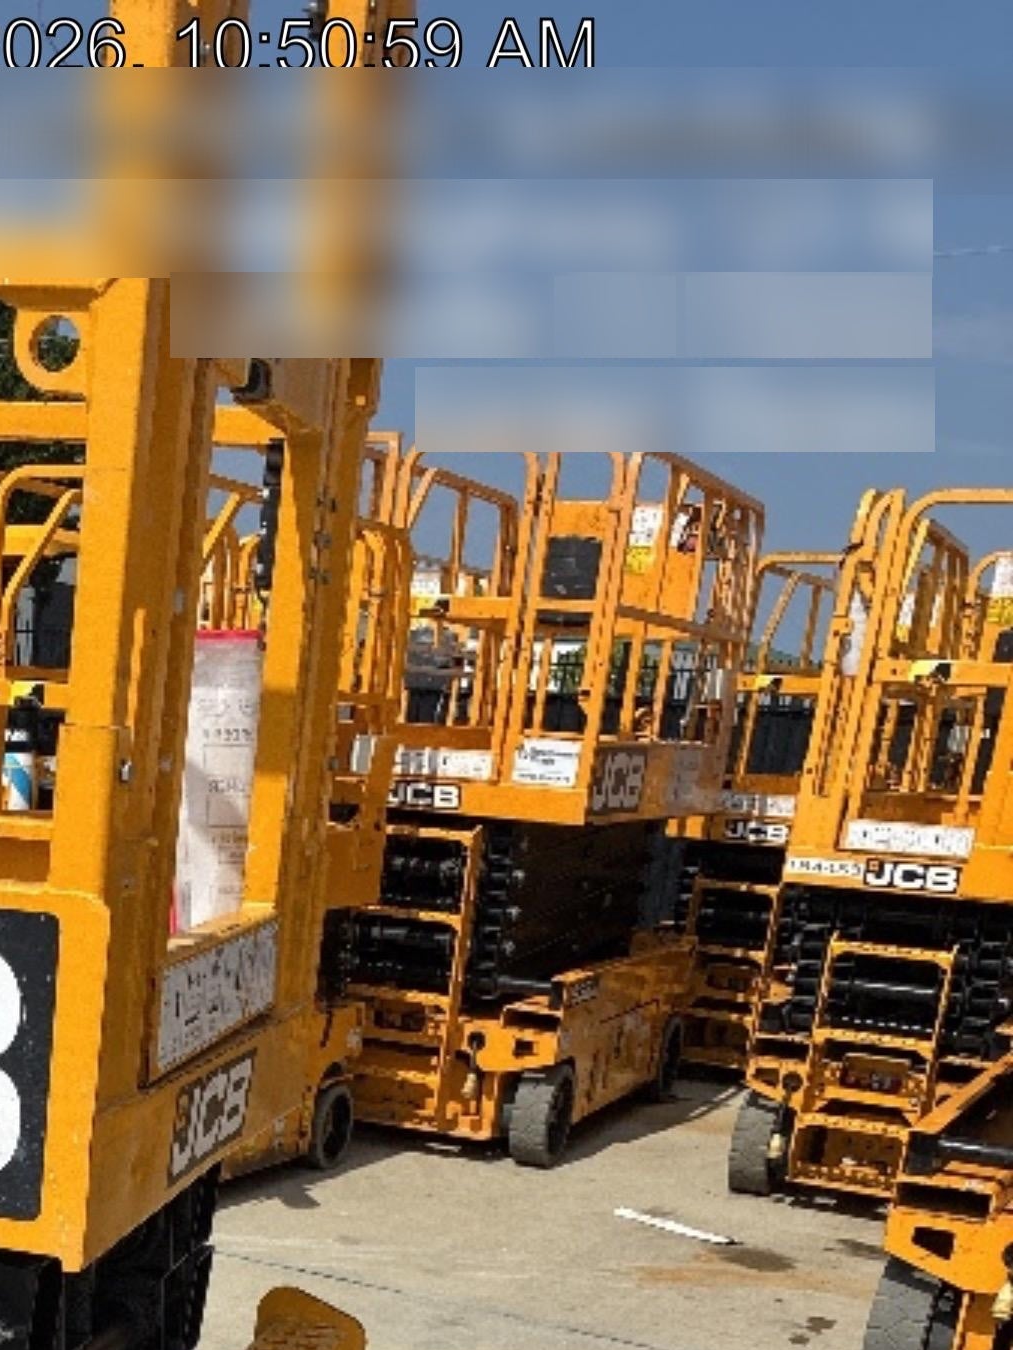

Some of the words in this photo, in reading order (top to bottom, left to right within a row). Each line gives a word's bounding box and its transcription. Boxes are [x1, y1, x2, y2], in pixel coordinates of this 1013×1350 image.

[389, 781, 460, 809] JCB
[593, 750, 645, 811] JCB
[724, 820, 789, 846] JCB
[865, 862, 958, 893] JCB
[171, 1057, 254, 1178] JCB
